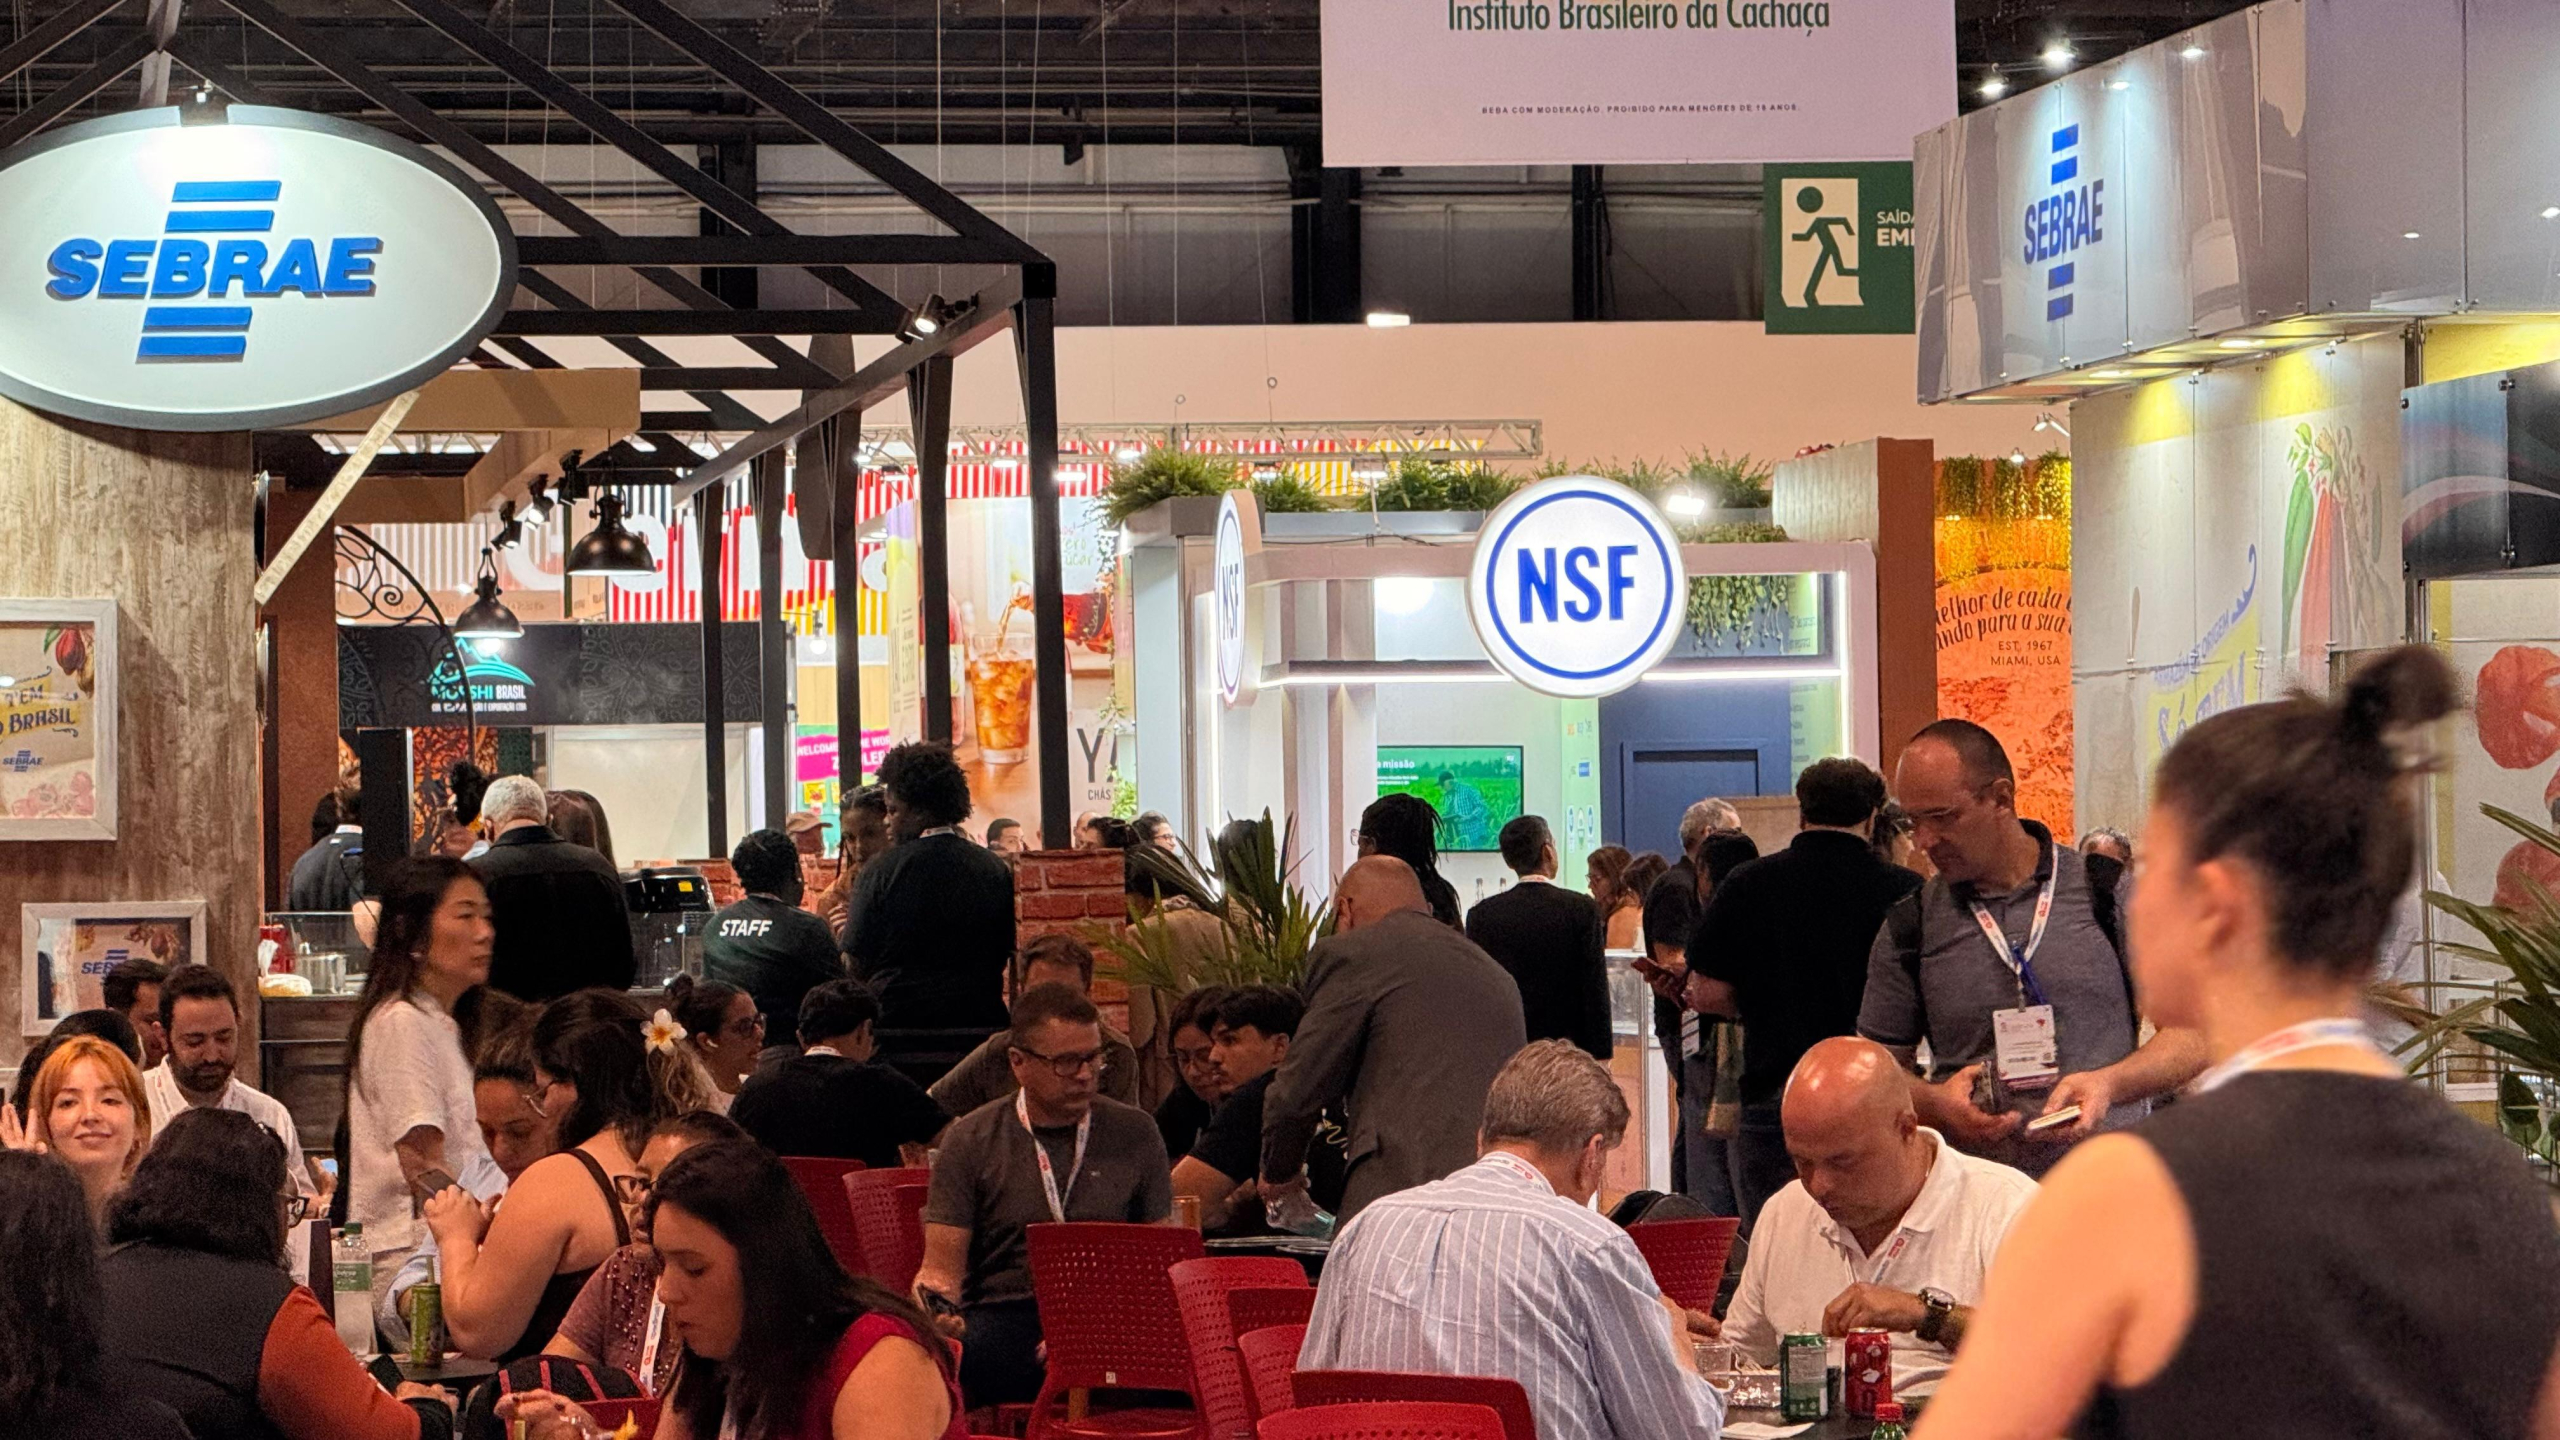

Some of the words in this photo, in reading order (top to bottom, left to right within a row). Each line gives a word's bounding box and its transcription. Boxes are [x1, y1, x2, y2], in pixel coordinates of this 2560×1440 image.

[1447, 0, 1550, 30] Instituto
[1559, 0, 1678, 30] Brasileiro
[1686, 0, 1718, 29] da
[1726, 0, 1830, 37] Cachaça
[1482, 105, 1508, 115] BEBA
[1511, 105, 1534, 114] COM
[1607, 104, 1655, 113] PROIBIDO
[1659, 105, 1685, 113] PARA
[1688, 104, 1736, 113] MENORES
[1739, 104, 1752, 112] DE
[2024, 178, 2105, 265] SEBRAE
[1877, 227, 1915, 247] EM
[46, 236, 383, 299] SEBRAE
[1517, 545, 1639, 624] NSF
[1222, 563, 1239, 641] NSF
[1992, 586, 2014, 611] de
[2017, 586, 2063, 611] cada
[1978, 613, 2018, 642] para
[2021, 613, 2033, 631] a
[2035, 613, 2066, 635] sua
[2026, 640, 2053, 652] 1967
[1991, 655, 2033, 668] MIAMI,
[2037, 655, 2062, 667] USA
[496, 684, 528, 700] BRASIL
[3, 757, 44, 766] SEBRAE
[1382, 758, 1416, 769] missão
[1088, 787, 1111, 801] CHÁS
[719, 919, 773, 937] STAFF
